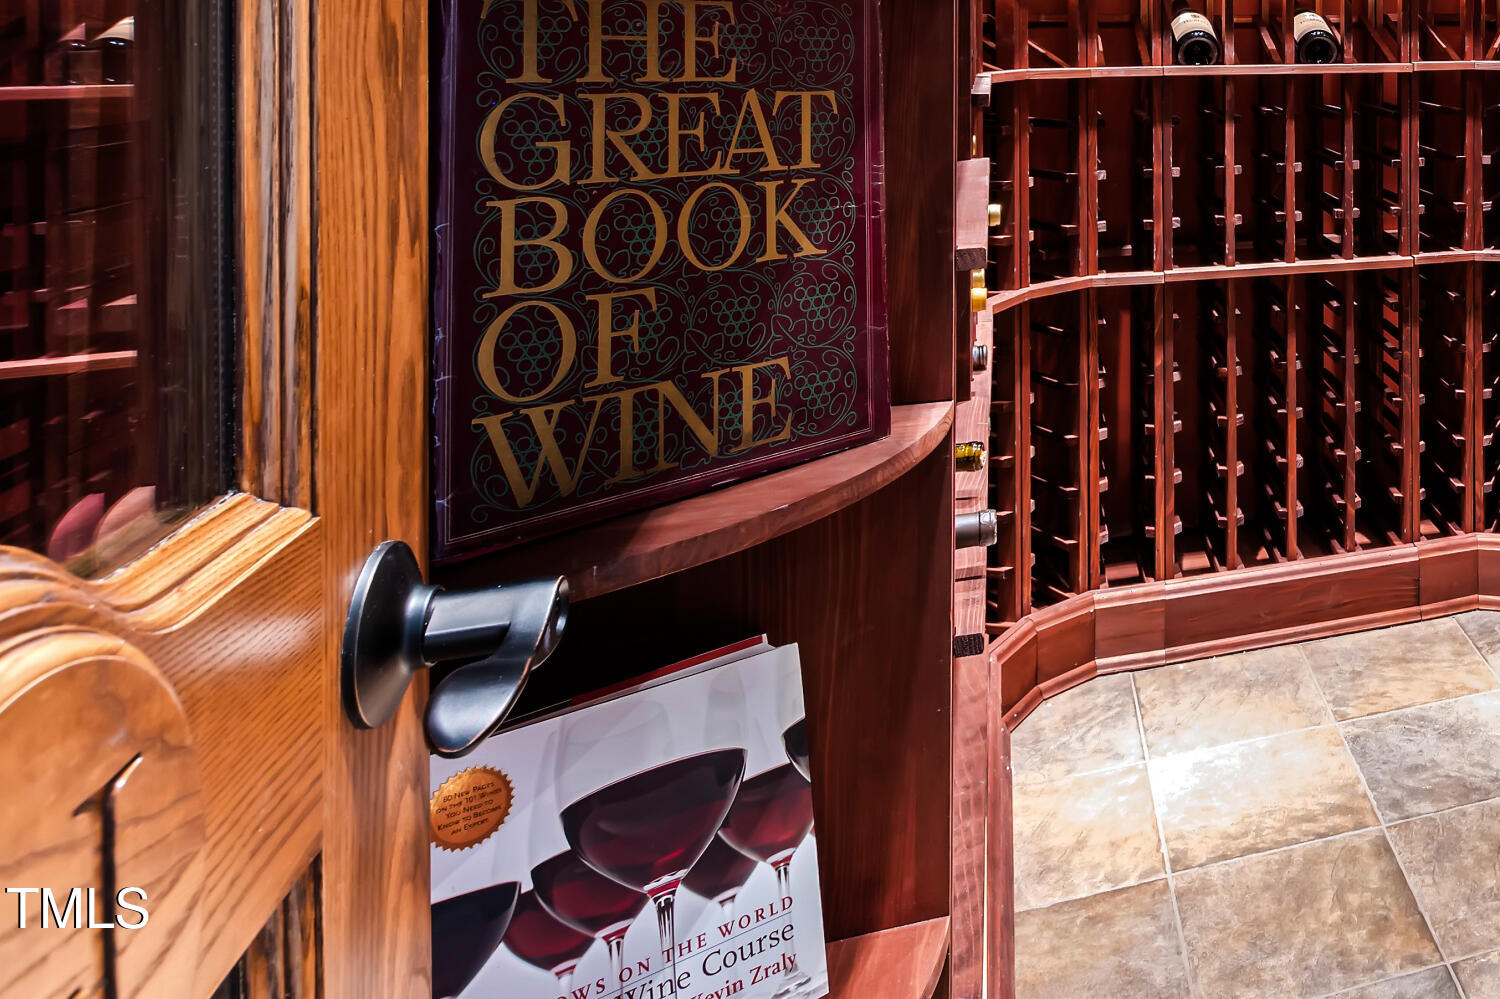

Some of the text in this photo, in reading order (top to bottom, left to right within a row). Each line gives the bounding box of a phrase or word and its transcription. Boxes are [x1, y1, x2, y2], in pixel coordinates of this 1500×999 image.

[479, 90, 838, 191] GREAT
[482, 177, 827, 298] BOOK
[476, 287, 657, 401] OF
[472, 356, 795, 508] WINE
[557, 896, 794, 999] WS ON THE WORLD
[702, 923, 795, 977] Course
[749, 952, 797, 986] Zraly
